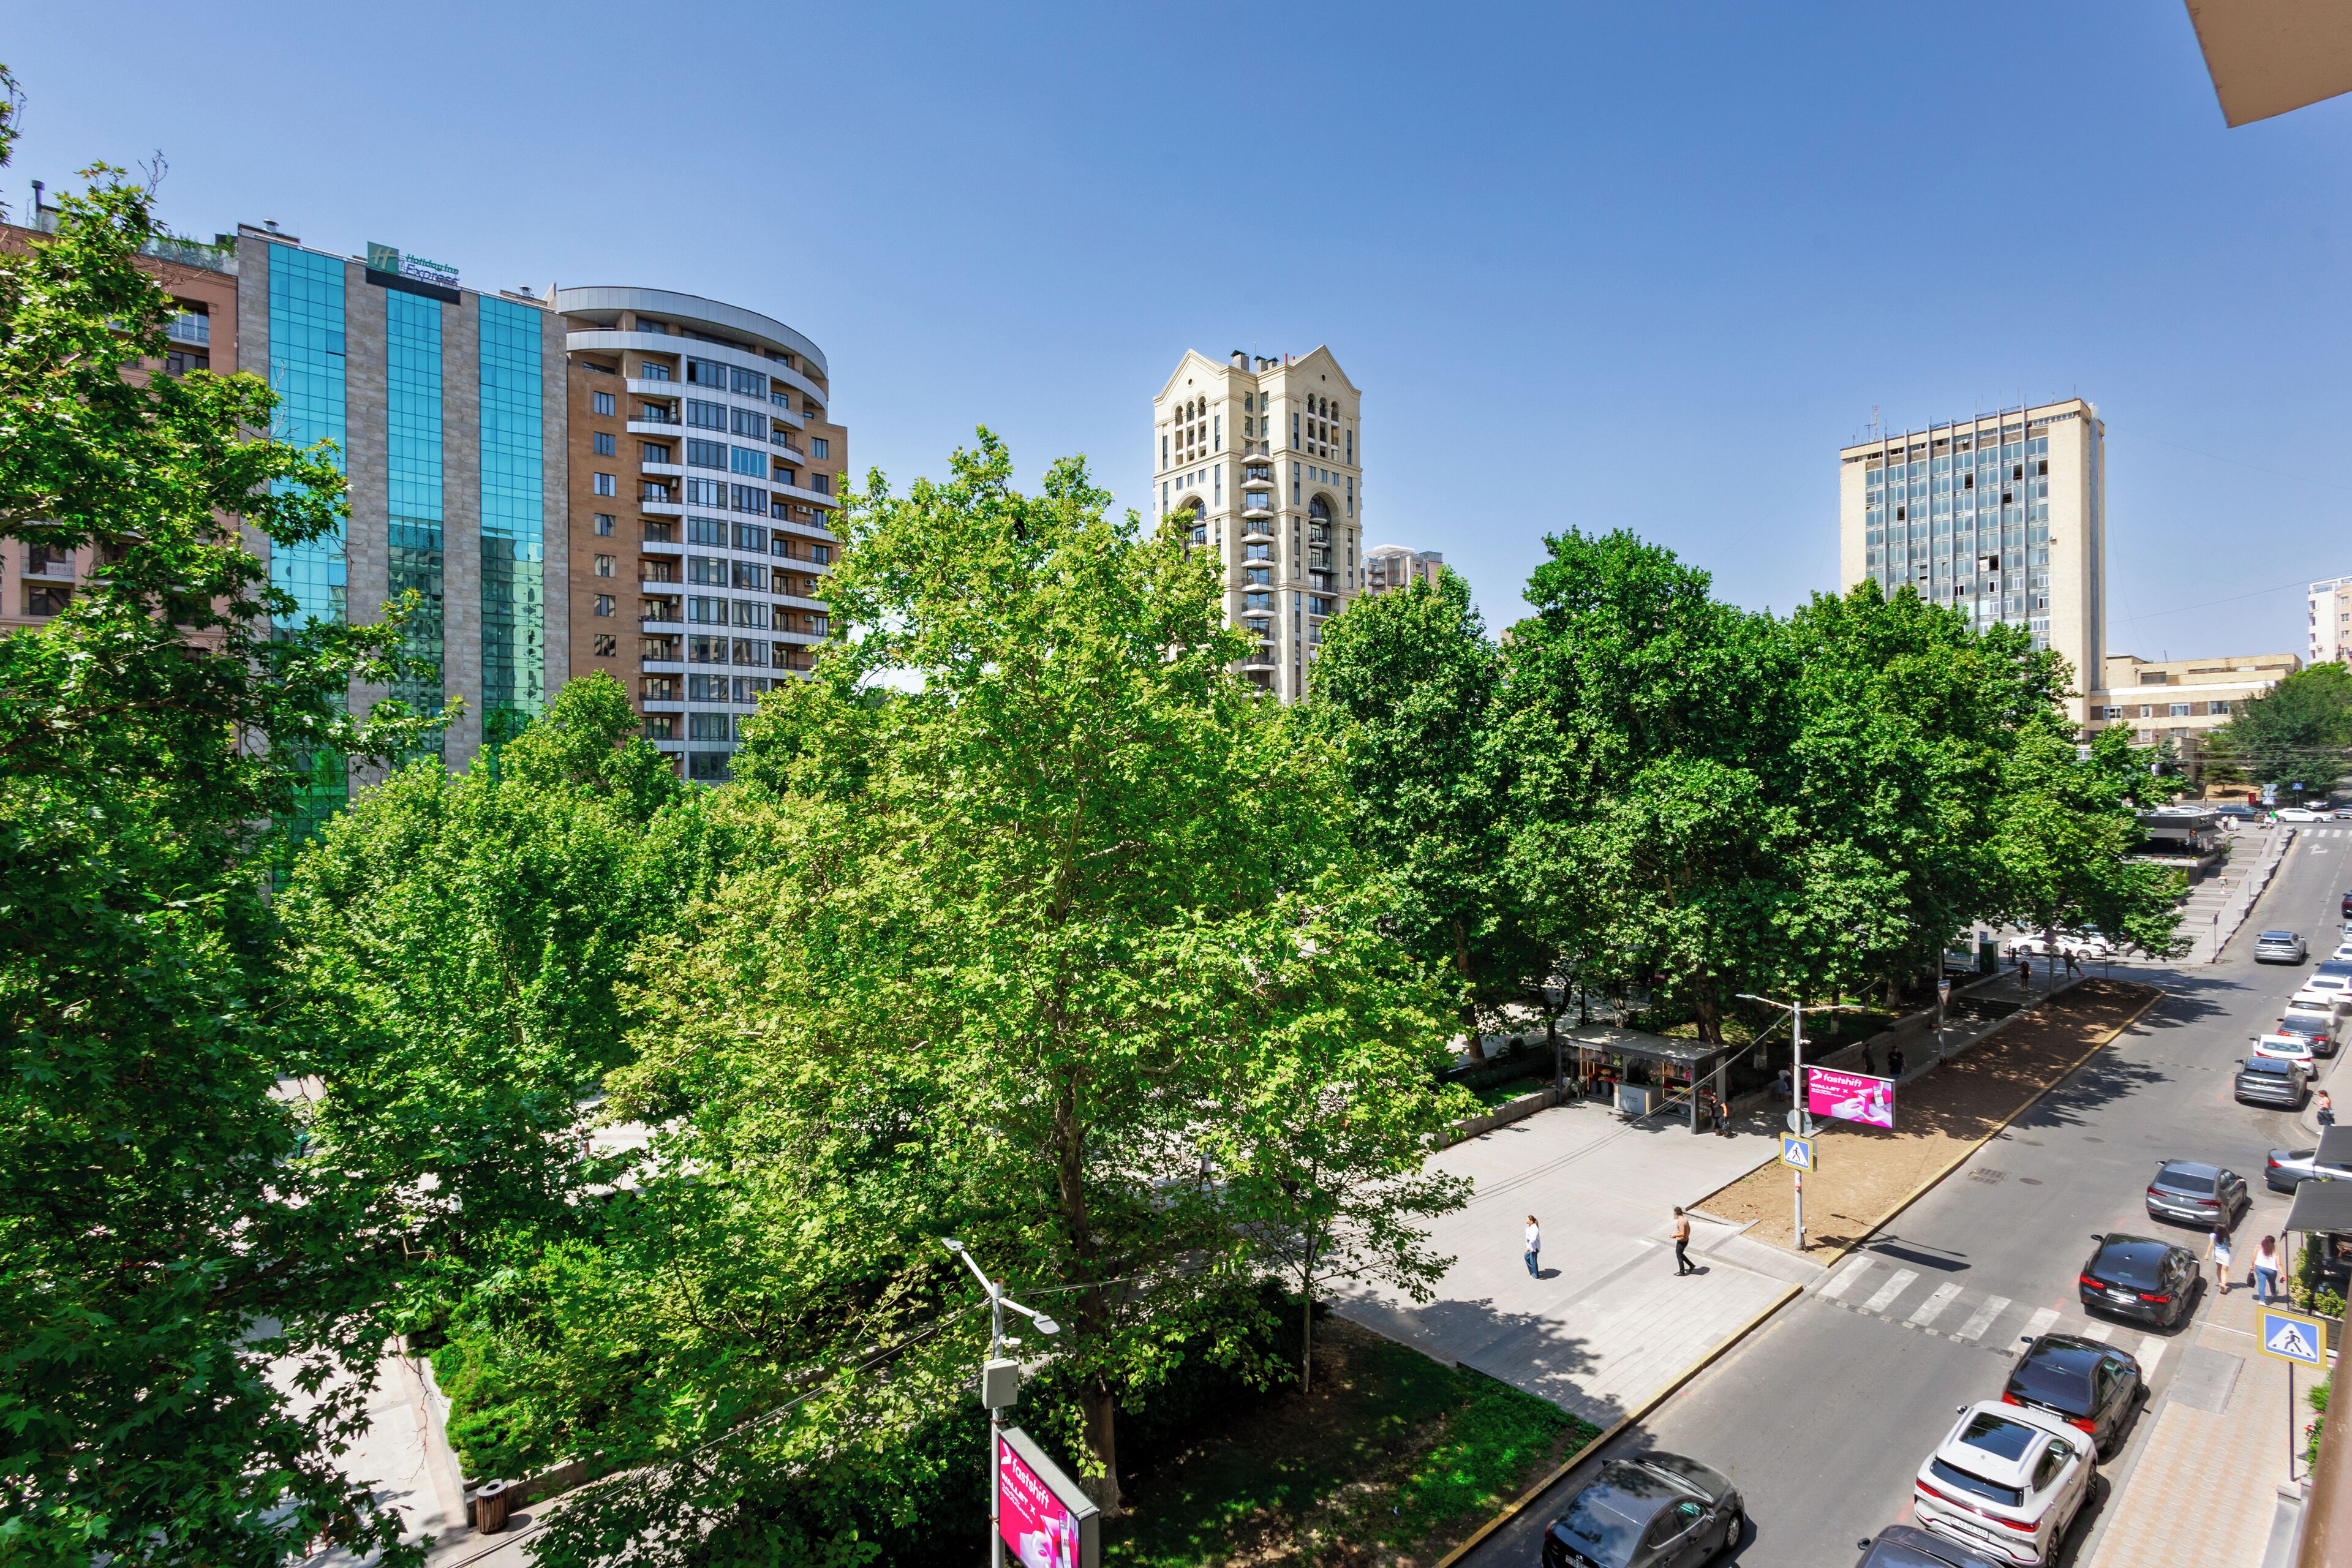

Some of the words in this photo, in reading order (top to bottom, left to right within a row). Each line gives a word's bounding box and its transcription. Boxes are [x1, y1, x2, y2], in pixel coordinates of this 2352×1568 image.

[406, 254, 442, 271] Holiday
[445, 263, 459, 274] Inn
[407, 264, 459, 285] Express
[1811, 1083, 1840, 1091] WALLET
[1823, 1074, 1862, 1087] fastshift
[1001, 1470, 1028, 1505] WALLET
[1012, 1458, 1049, 1509] fastshift
